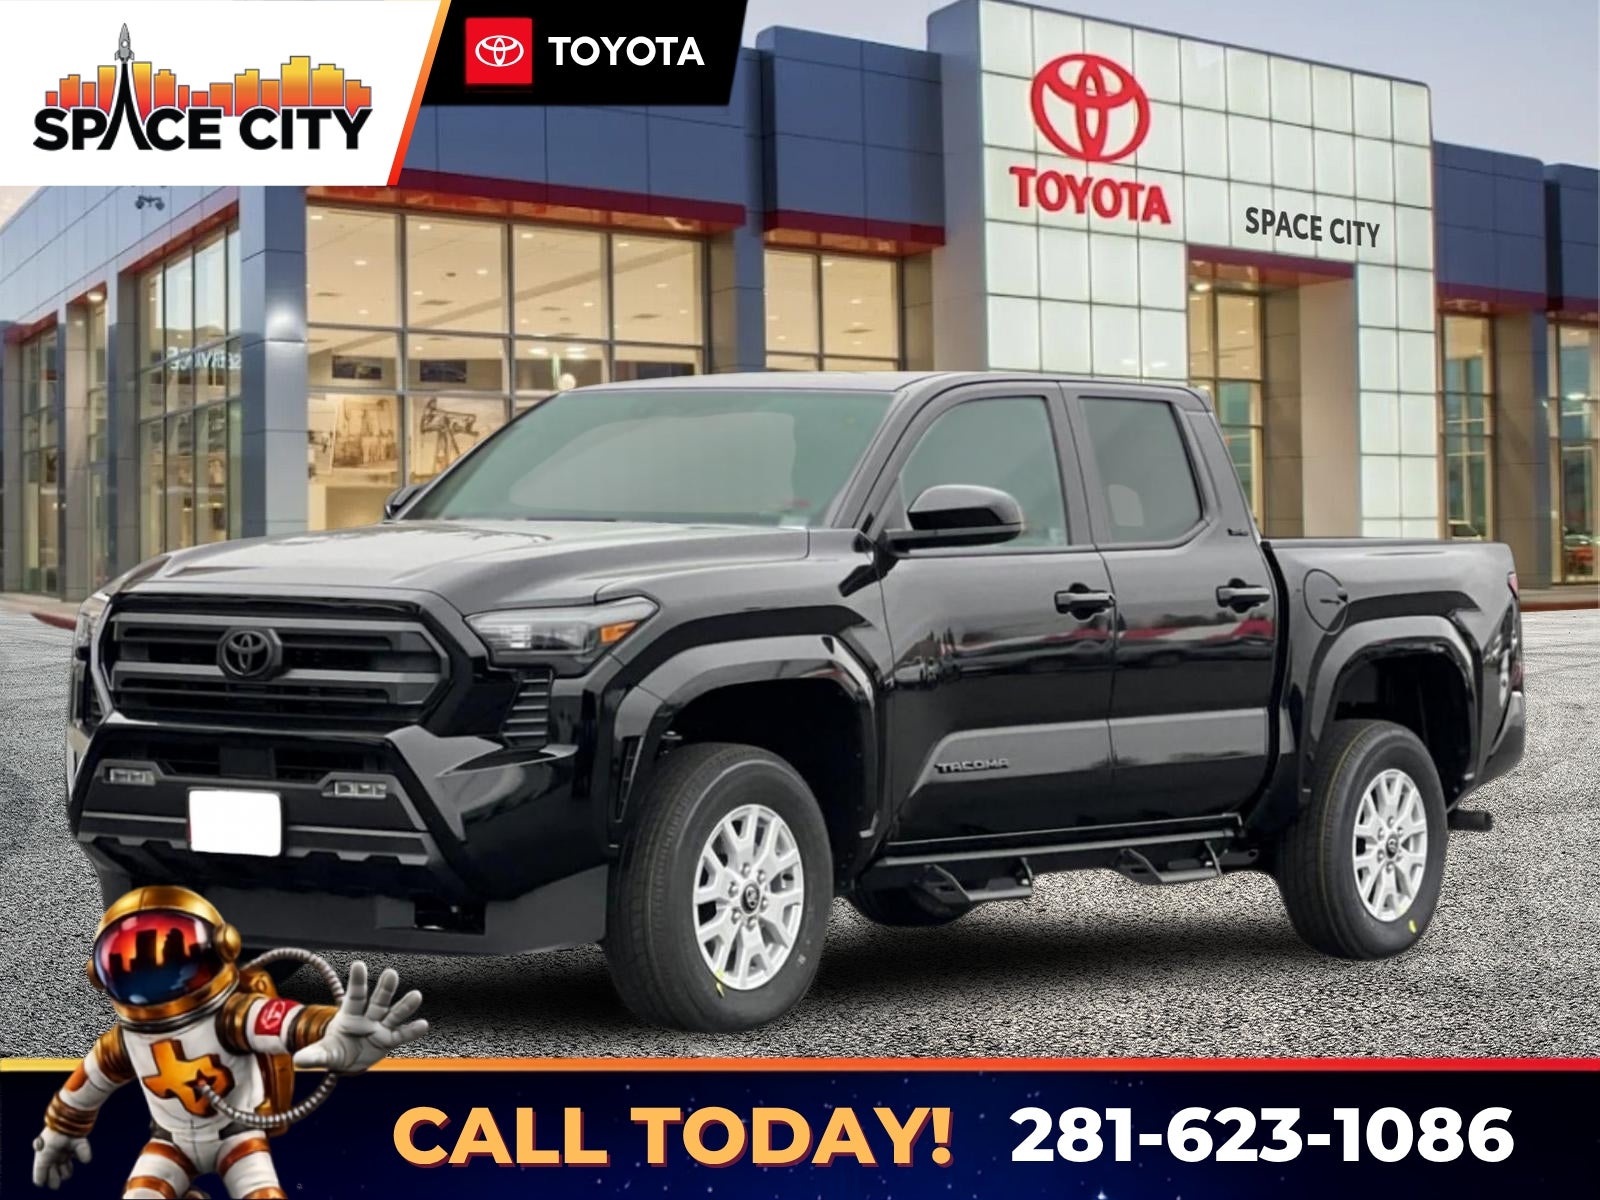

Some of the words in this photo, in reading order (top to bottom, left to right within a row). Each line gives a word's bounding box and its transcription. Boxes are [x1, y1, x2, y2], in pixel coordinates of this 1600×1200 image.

[1009, 166, 1171, 225] TOYOTA
[1245, 206, 1323, 242] SPACE
[1329, 217, 1381, 248] CITY
[935, 759, 1009, 774] TACOMA
